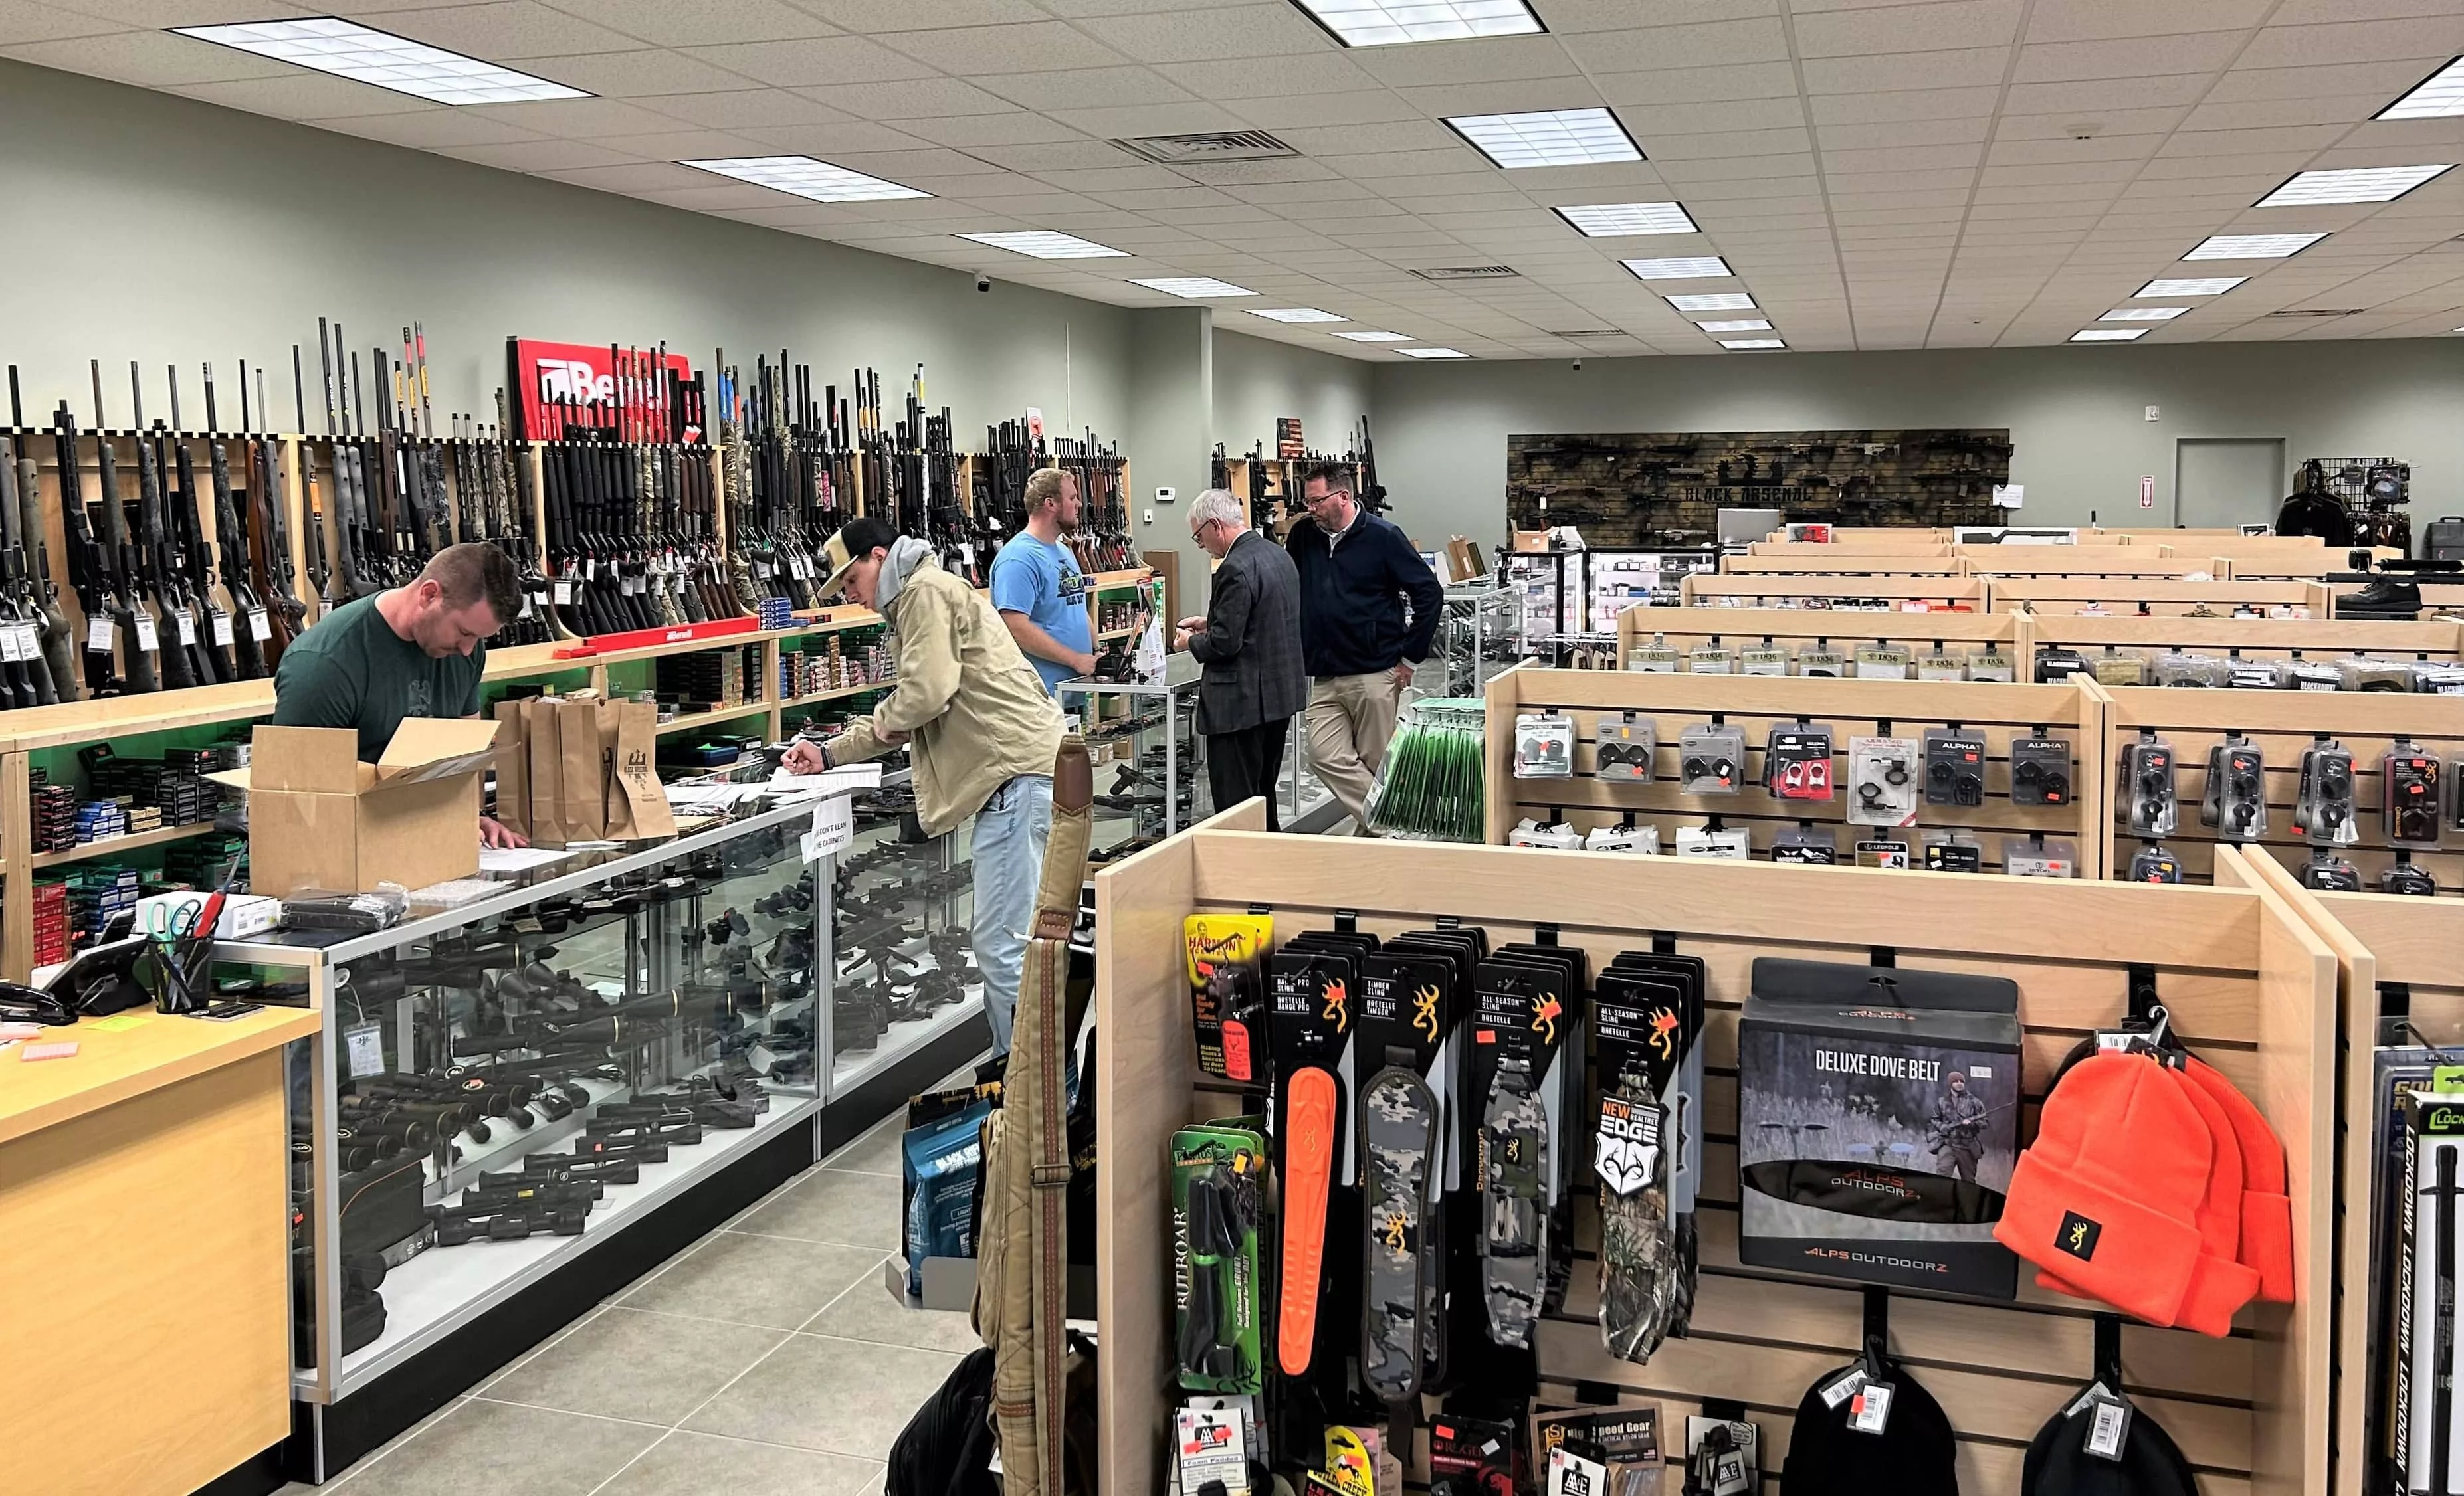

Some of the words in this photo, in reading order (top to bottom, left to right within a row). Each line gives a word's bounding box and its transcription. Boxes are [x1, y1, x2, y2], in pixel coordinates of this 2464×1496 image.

[1685, 487, 1733, 502] BLACK
[1741, 487, 1812, 502] ARSENAL
[835, 820, 847, 830] LEAN
[1367, 980, 1390, 990] TIMBER
[1367, 988, 1386, 996] SLING
[1366, 1006, 1389, 1016] TIMBER
[1482, 1002, 1500, 1011] SLING
[1481, 1014, 1512, 1025] BRETELLE
[1601, 1014, 1619, 1024] SLING
[1601, 1026, 1630, 1038] BRETELLE
[1815, 1049, 1867, 1076] DELUXE
[1870, 1054, 1906, 1079] DOVE
[1908, 1058, 1941, 1083] BELT
[1602, 1101, 1629, 1119] NEW
[1630, 1114, 1659, 1126] REALTREE
[1600, 1116, 1659, 1143] EDGE
[1841, 1169, 1904, 1188] ALPS
[2402, 1123, 2416, 1236] LOCKDOWN
[1831, 1177, 1918, 1199] OUTDOORZ
[1174, 1210, 1189, 1311] RUTROAR
[1804, 1246, 1849, 1260] ALPS
[1851, 1252, 1950, 1273] OUTDOORZ
[2400, 1242, 2412, 1356] LOCKDOWN
[2395, 1359, 2410, 1473] LOCKDOWN
[1626, 1421, 1651, 1433] Gear
